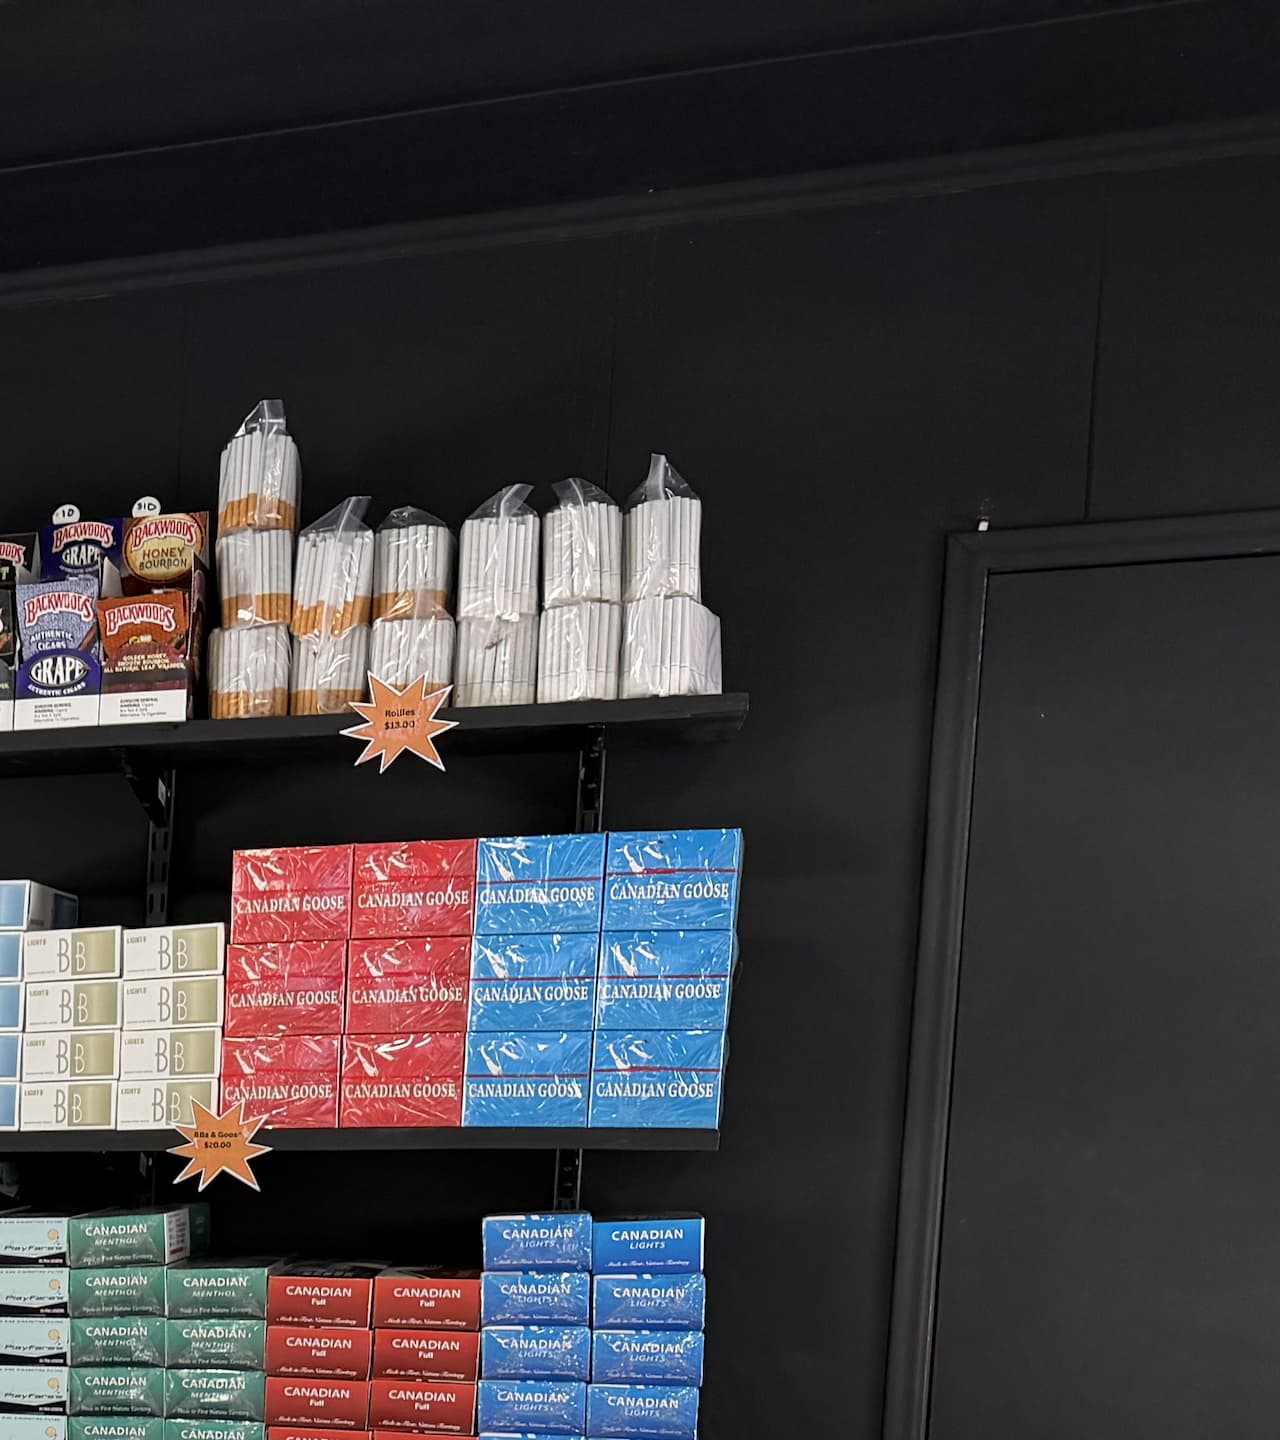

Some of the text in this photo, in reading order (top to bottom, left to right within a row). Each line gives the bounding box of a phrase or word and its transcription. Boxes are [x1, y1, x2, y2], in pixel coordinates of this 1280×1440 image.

[142, 547, 186, 561] HONEY
[139, 557, 187, 570] BOURBON
[29, 657, 86, 684] GRAPE
[385, 709, 415, 717] Rollies
[358, 889, 469, 910] CANADIAN GOOSE
[351, 987, 463, 1005] CANADIAN GOOSE
[225, 1084, 333, 1101] CANADIAN GOOSE
[345, 1082, 456, 1099] CANADIAN GOOSE
[95, 1237, 138, 1246] MENTHOL
[611, 1228, 684, 1242] CANADIAN
[630, 1241, 666, 1250] LIGHTS
[286, 1286, 352, 1298] CANADIAN
[311, 1298, 326, 1307] Full
[608, 1396, 679, 1409] CANADIAN
